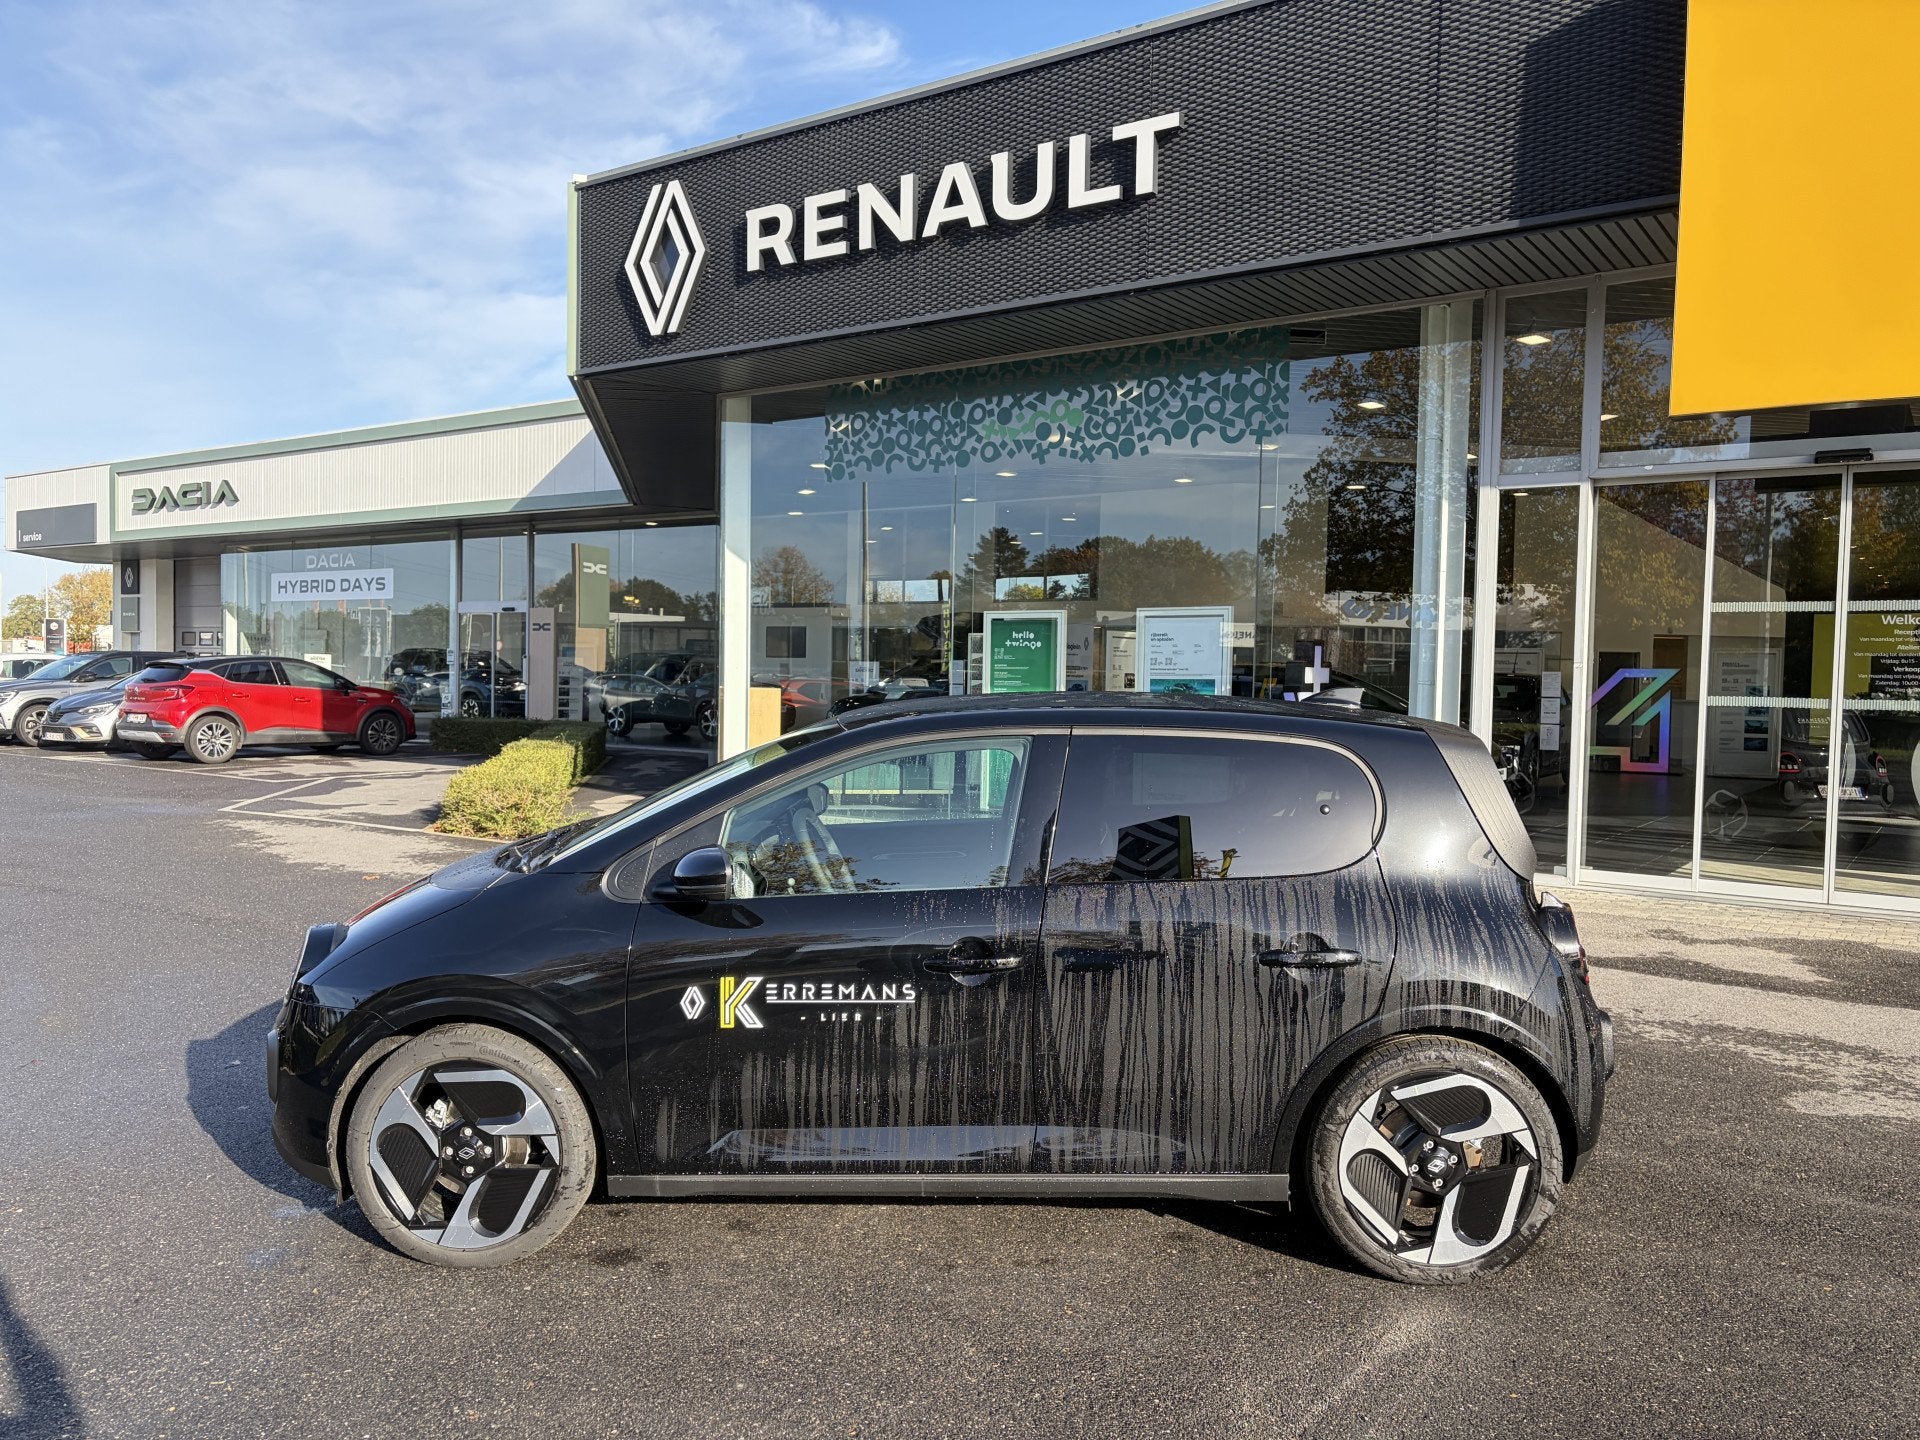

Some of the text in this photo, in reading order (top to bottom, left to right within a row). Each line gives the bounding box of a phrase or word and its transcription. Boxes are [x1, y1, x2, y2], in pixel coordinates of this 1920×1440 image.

[745, 111, 1184, 272] RENAULT
[132, 479, 240, 511] DACIA
[23, 532, 42, 542] service
[306, 553, 356, 569] DACIA
[277, 576, 386, 594] HYBRID DAYS
[1012, 631, 1035, 639] hello
[720, 976, 916, 1029] KERREMANS
[820, 1012, 862, 1022] LIER
